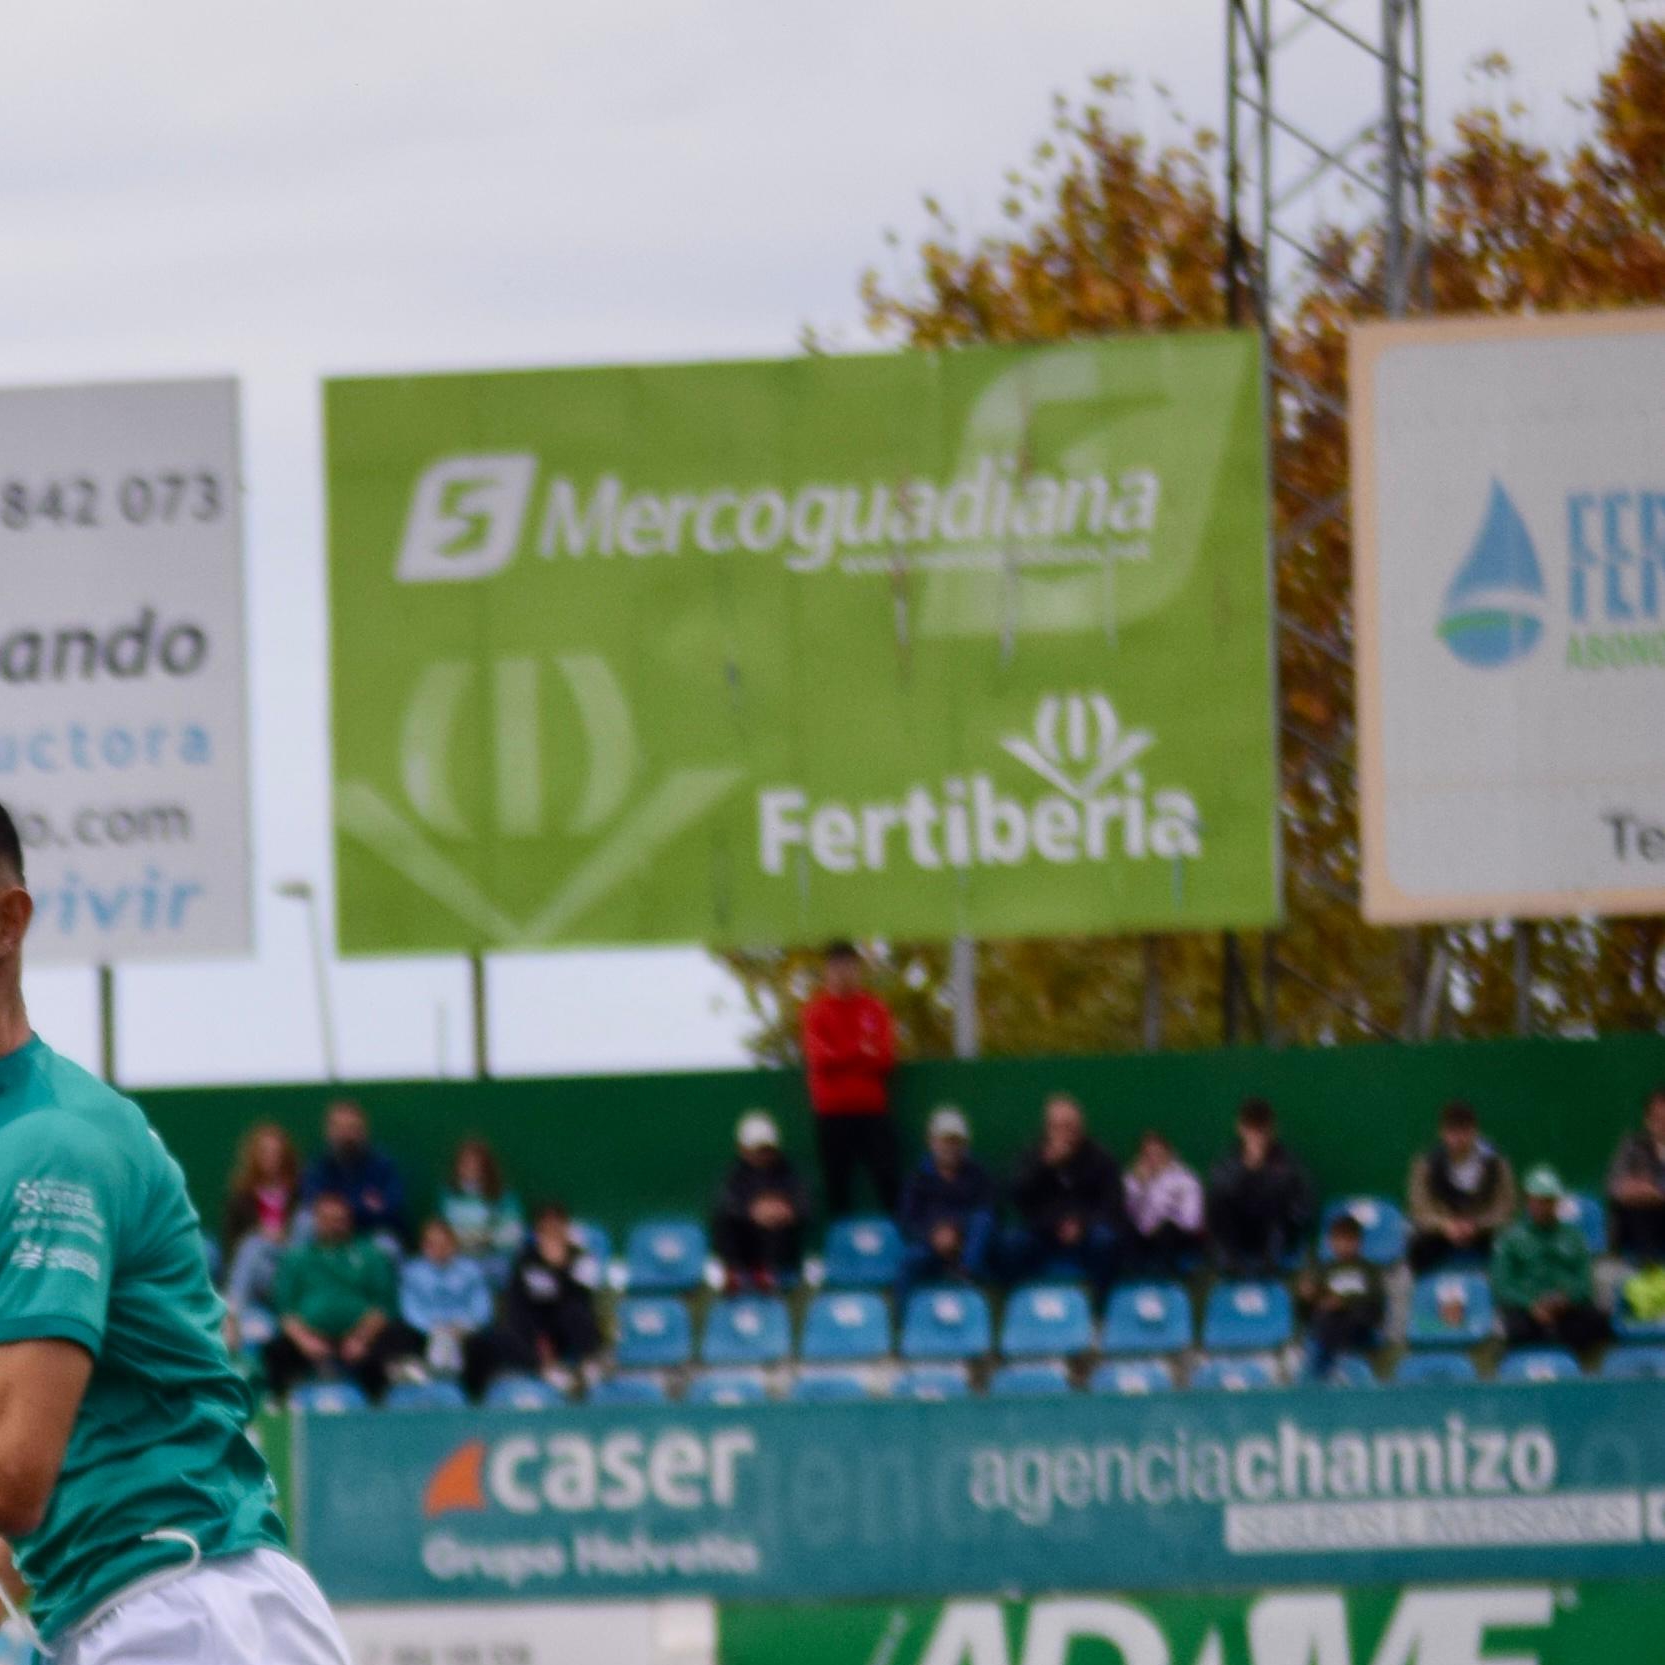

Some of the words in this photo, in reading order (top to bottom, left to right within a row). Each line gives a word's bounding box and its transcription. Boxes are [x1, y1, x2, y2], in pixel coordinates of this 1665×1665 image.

[120, 470, 224, 526] 073
[538, 458, 1160, 575] Mercoguadiana
[758, 768, 1202, 878] Fertiberia
[488, 1425, 758, 1514] caser
[970, 1413, 1558, 1526] agenciachamizo
